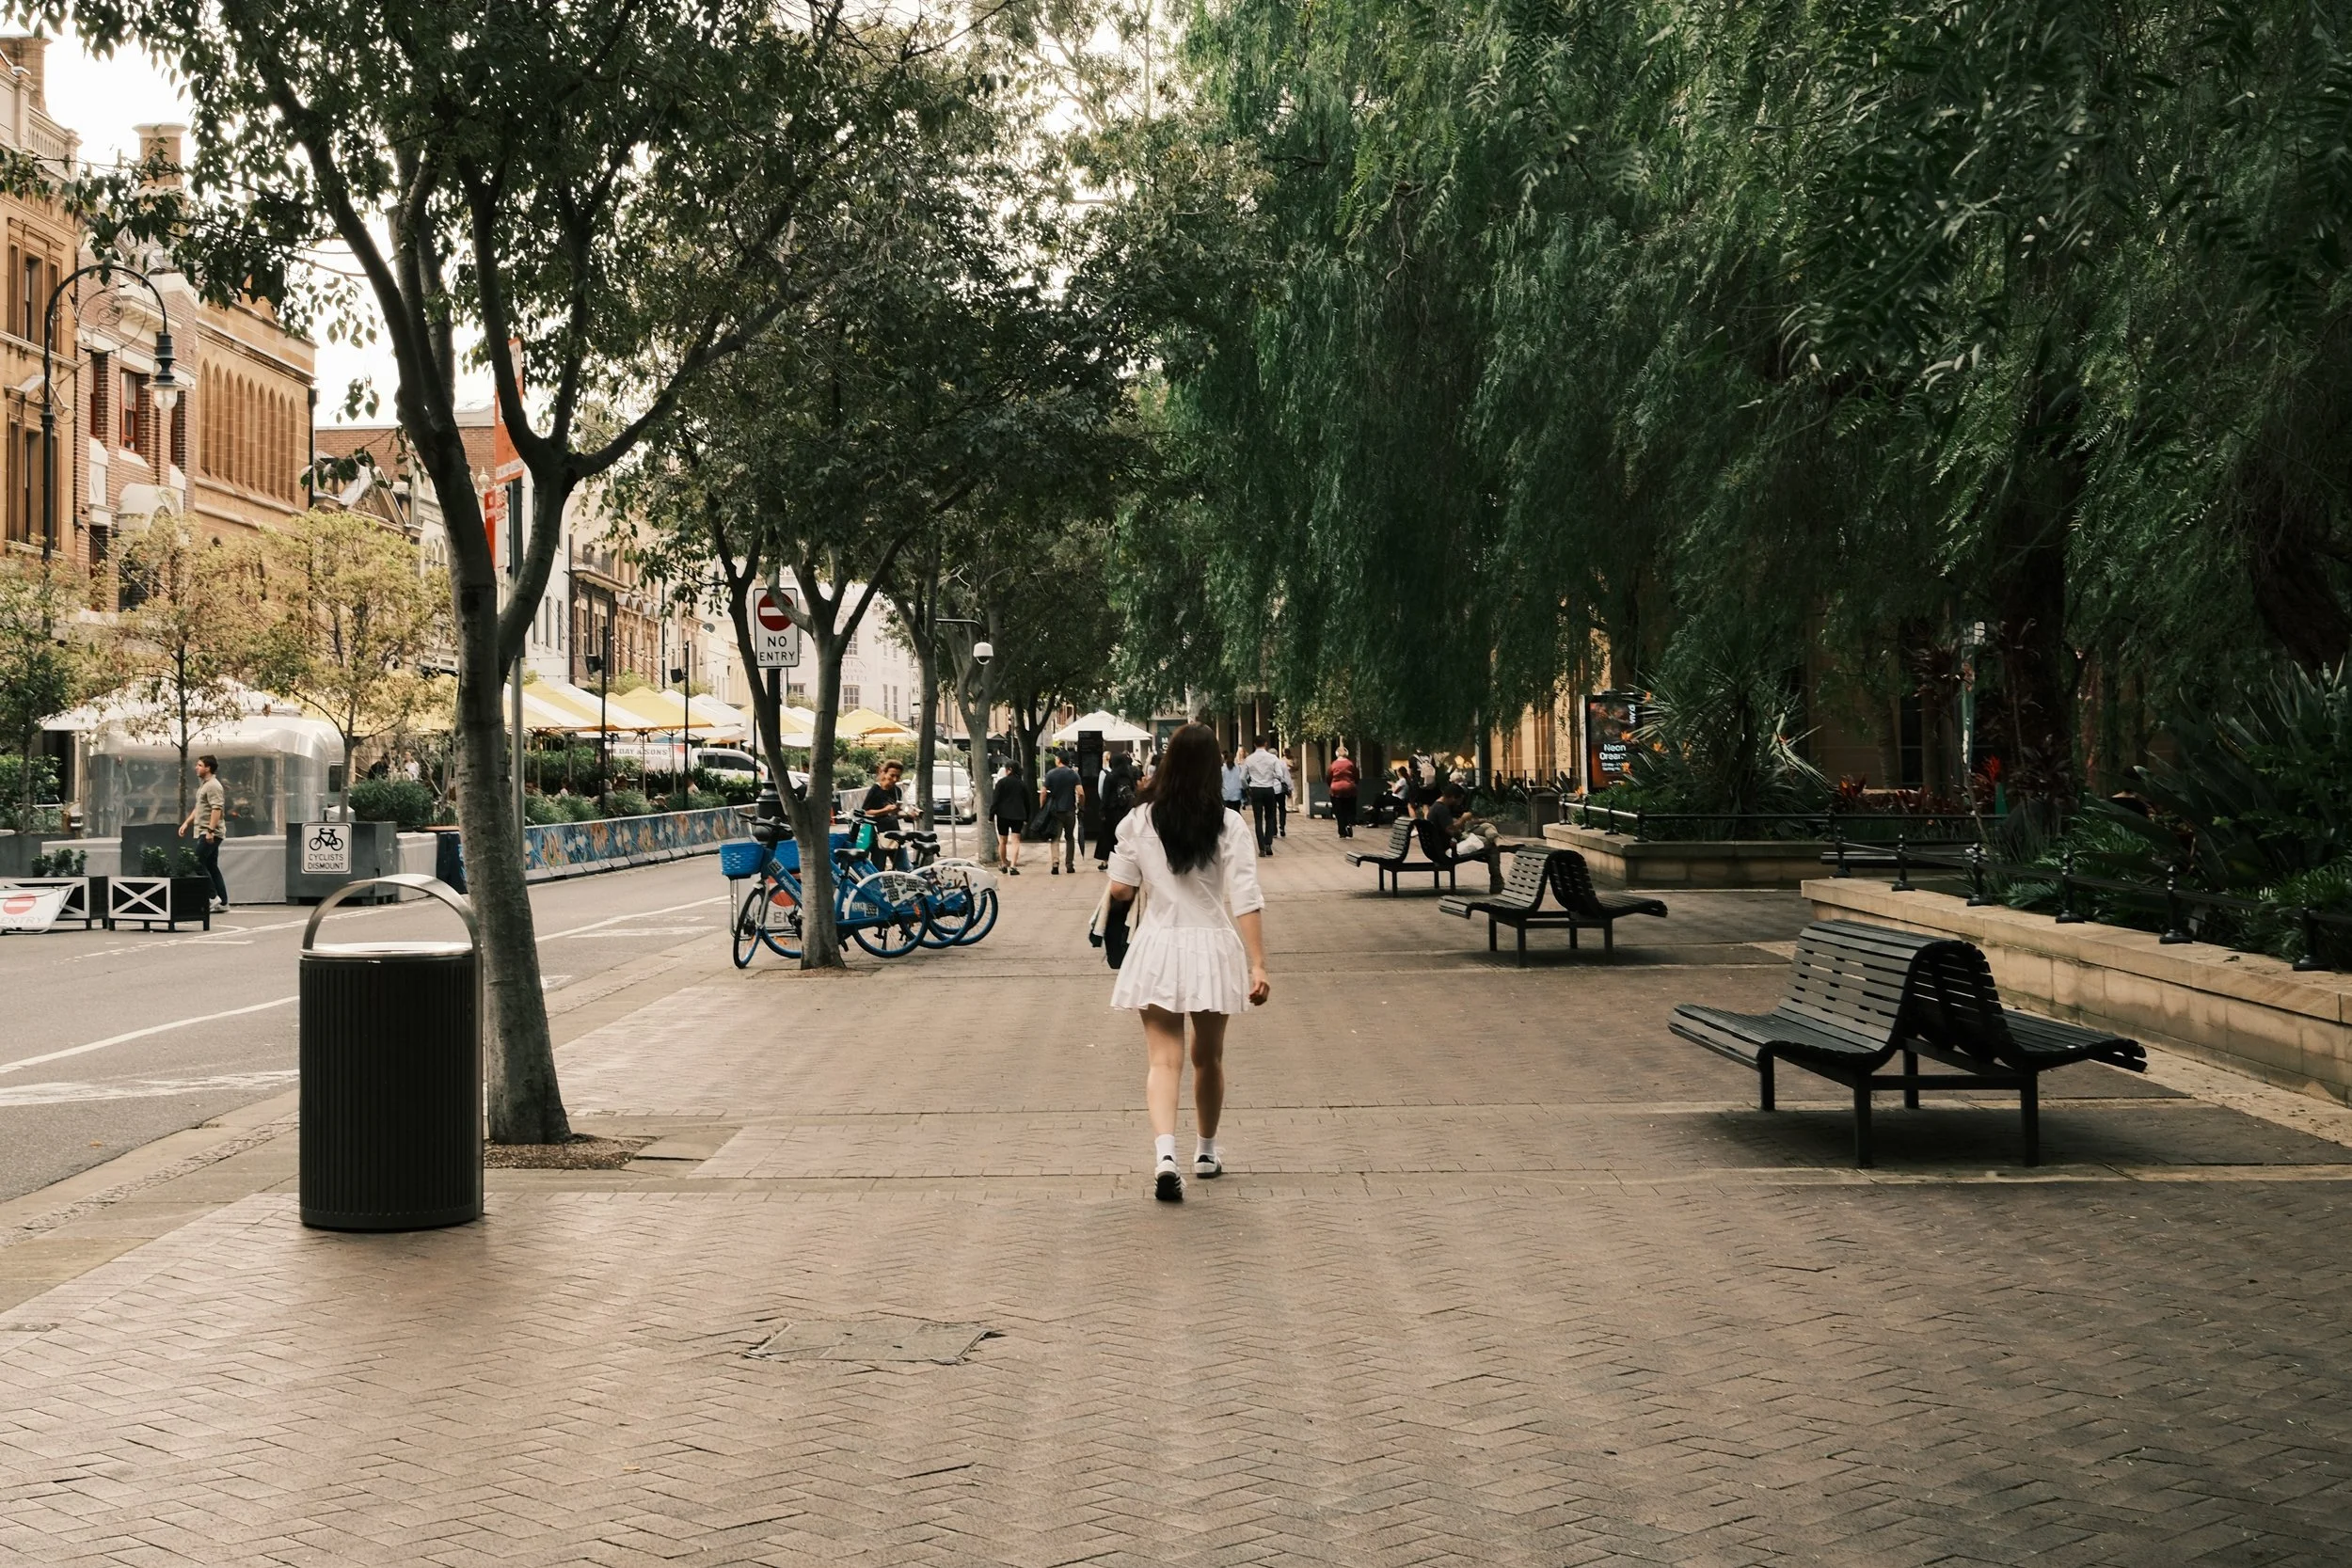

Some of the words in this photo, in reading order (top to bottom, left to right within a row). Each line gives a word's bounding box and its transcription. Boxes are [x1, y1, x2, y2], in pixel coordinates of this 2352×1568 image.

[767, 636, 787, 647] NO
[759, 651, 795, 661] ENTRY
[1628, 704, 1636, 724] vivd
[1603, 743, 1627, 752] Neon
[1599, 752, 1626, 761] Drea
[308, 853, 344, 862] CYCLISTS
[0, 916, 43, 925] ENTRY
